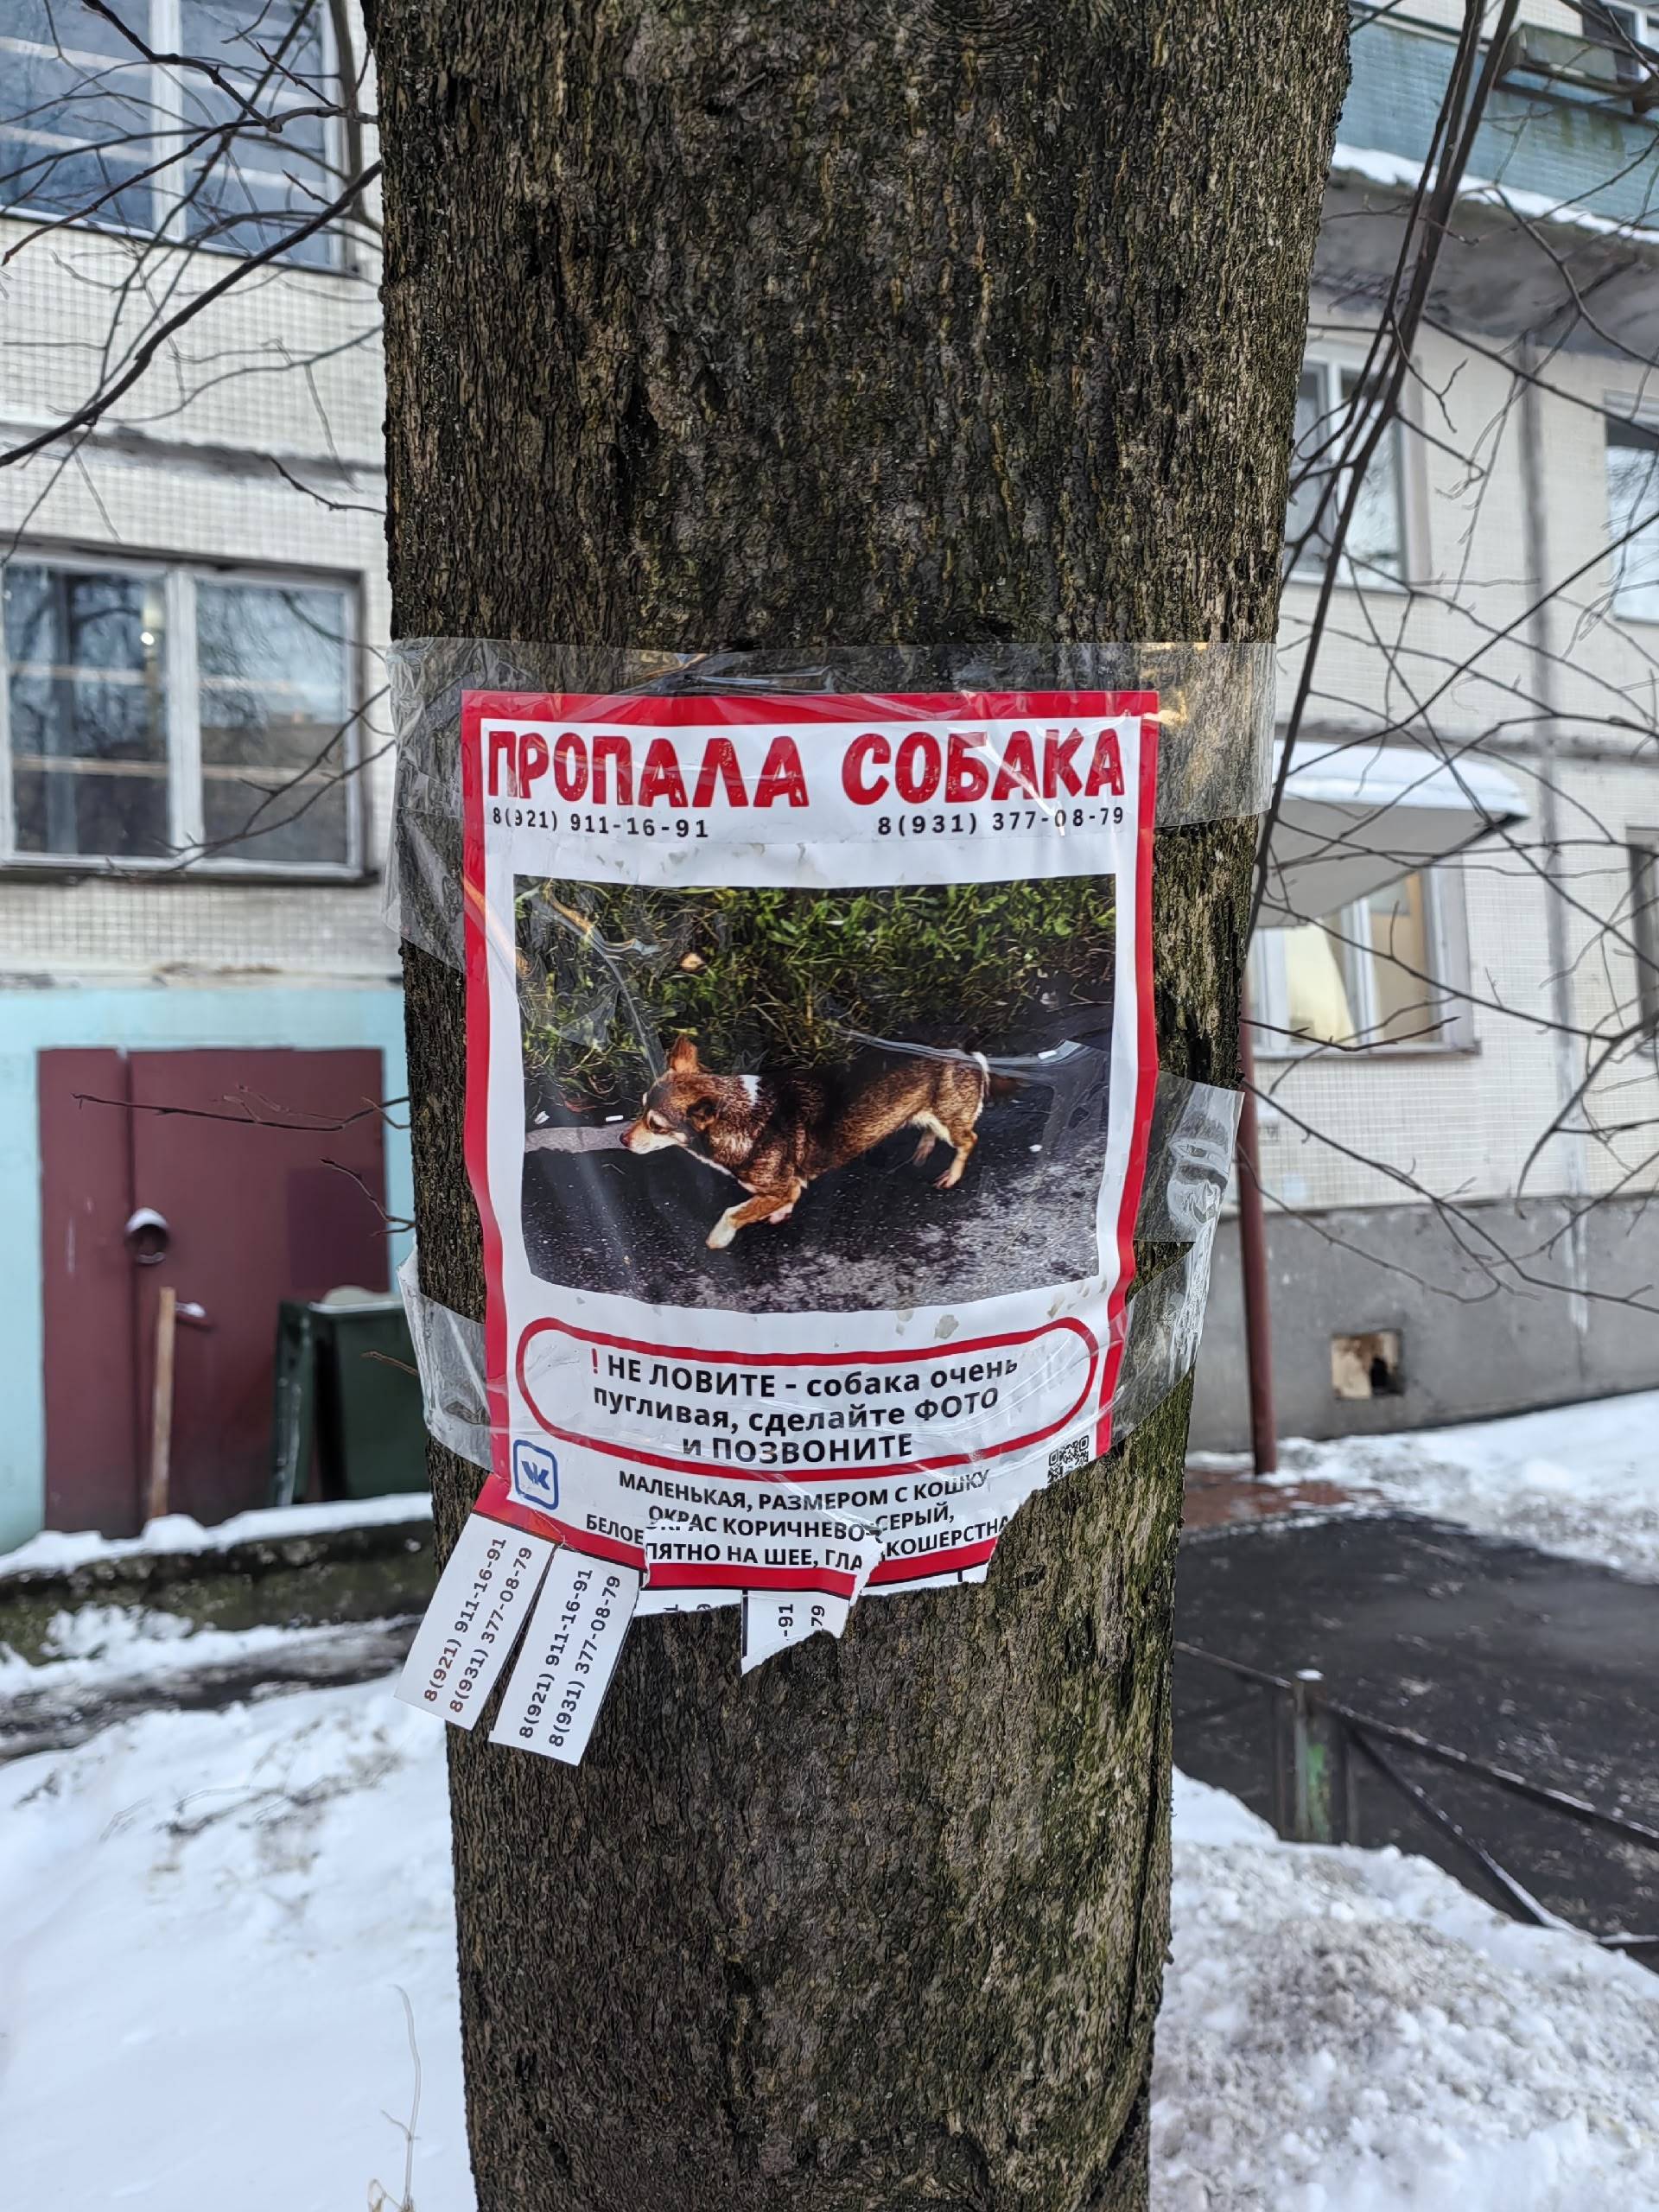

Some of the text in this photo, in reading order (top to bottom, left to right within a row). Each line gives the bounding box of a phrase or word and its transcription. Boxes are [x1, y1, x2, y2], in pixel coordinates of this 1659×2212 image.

[488, 728, 1125, 808] ПРОПАЛА СОБАКА
[493, 807, 709, 838] 8(921) 911-16-91
[878, 807, 1123, 836] 8(931) 377-08-79
[649, 1363, 775, 1397] ЛОВИТЕ
[807, 1370, 920, 1397] собака
[931, 1359, 1018, 1388] очень
[594, 1387, 999, 1437] пугливая, сделайте ФОТО
[683, 1433, 912, 1464] и ПОЗВОНИТЕ
[619, 1469, 990, 1513] МАЛЕНЬКАЯ, РАЗМЕРОМ С КОШКУ
[586, 1514, 644, 1545] БЕЛОЕ
[646, 1542, 721, 1561] ПЯТНО
[727, 1545, 758, 1564] НА
[765, 1548, 819, 1568] ШЕЕ,
[647, 1505, 717, 1532] ОКРАС
[424, 1538, 507, 1701] 8(921) 911-16-91
[449, 1548, 532, 1713] 8(931) 377-08-79
[519, 1569, 593, 1738] 8(921) 911-16-91
[549, 1575, 620, 1747] 8(931) 377-08-79
